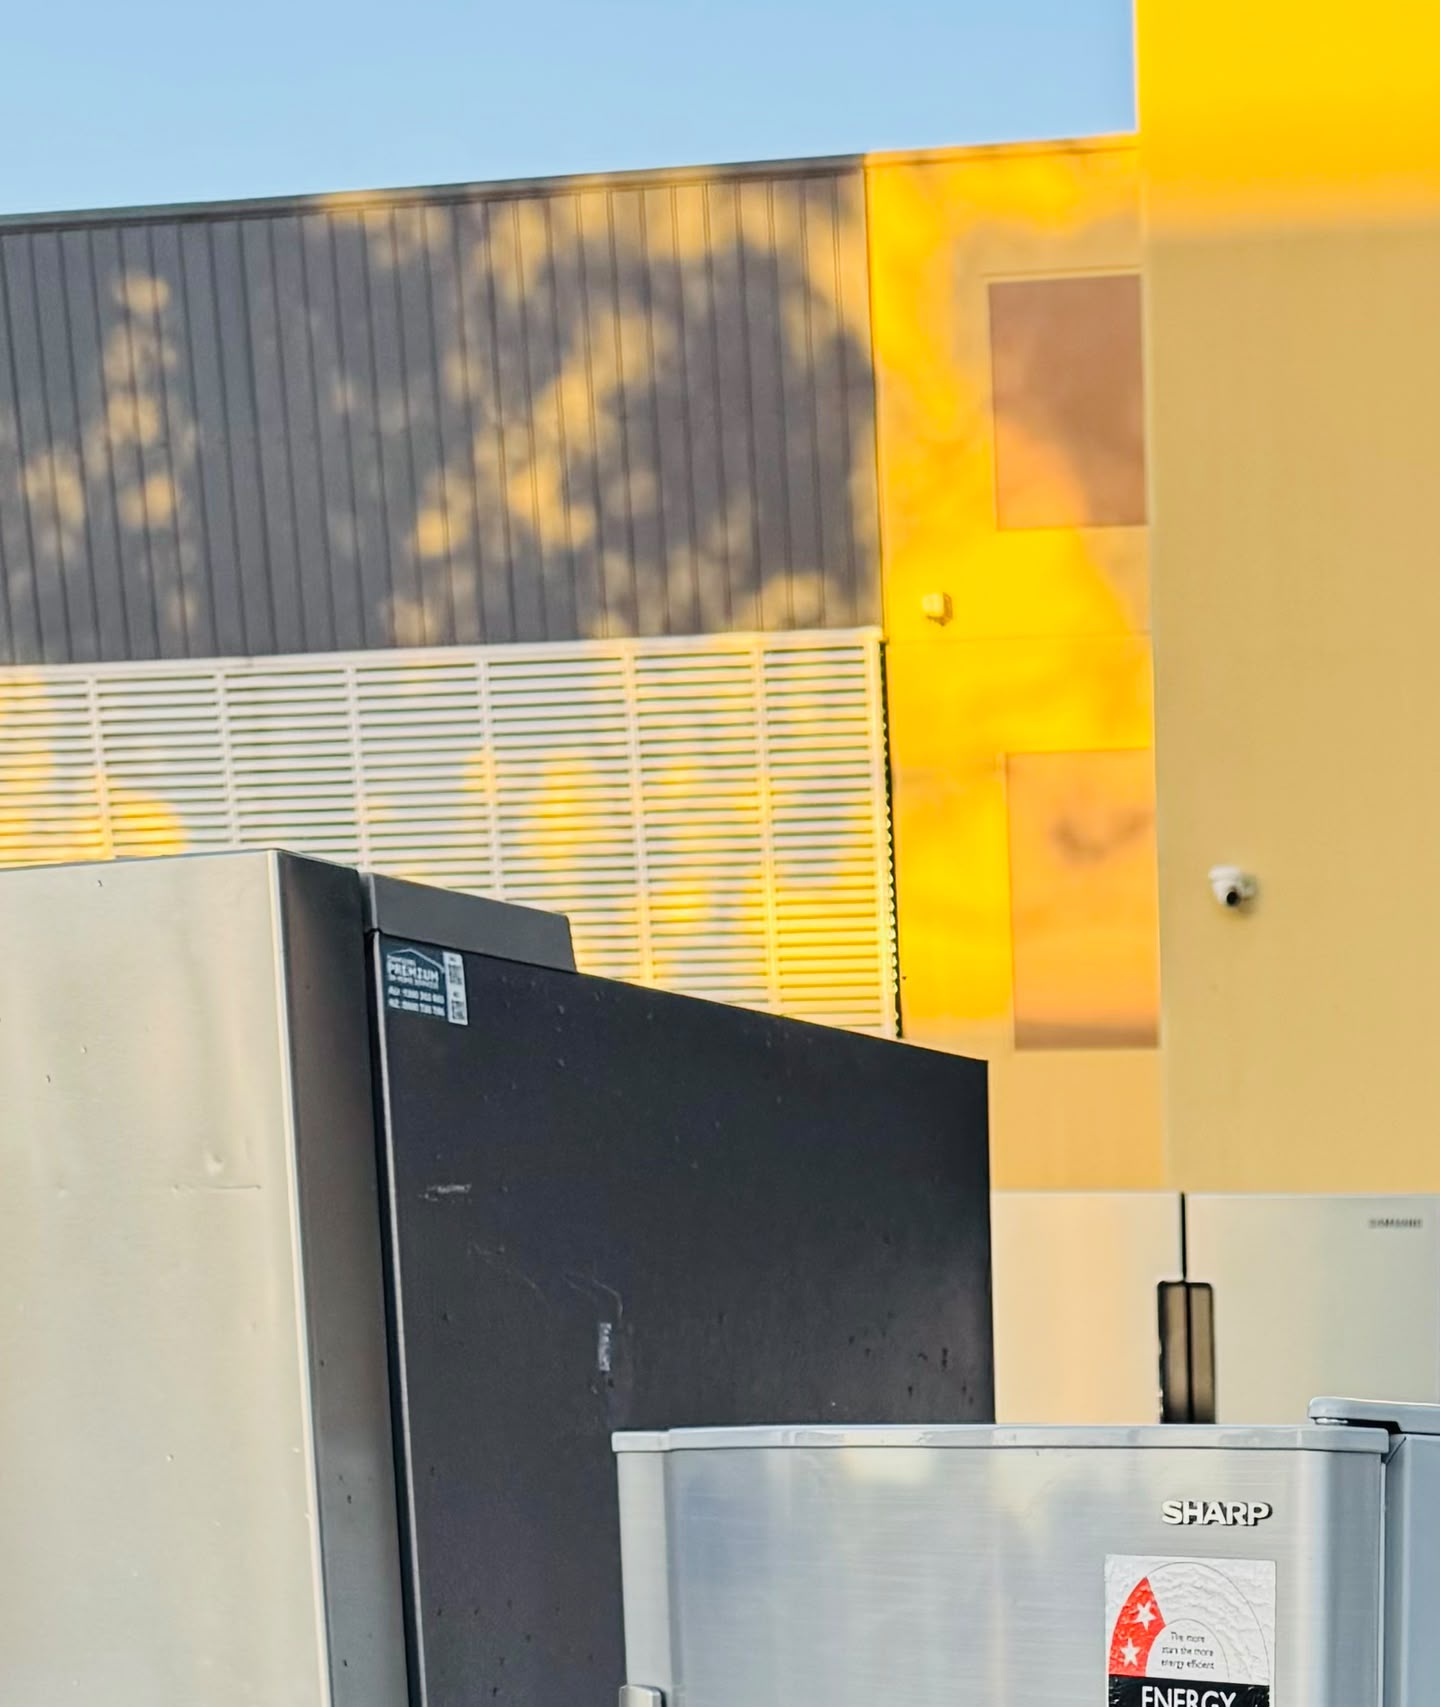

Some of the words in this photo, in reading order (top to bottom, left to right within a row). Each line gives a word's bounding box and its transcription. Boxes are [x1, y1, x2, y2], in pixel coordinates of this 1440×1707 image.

[1161, 1500, 1273, 1526] SHARP
[1170, 1631, 1184, 1641] The
[1186, 1634, 1205, 1643] more
[1180, 1647, 1192, 1655] the
[1161, 1659, 1184, 1670] energy
